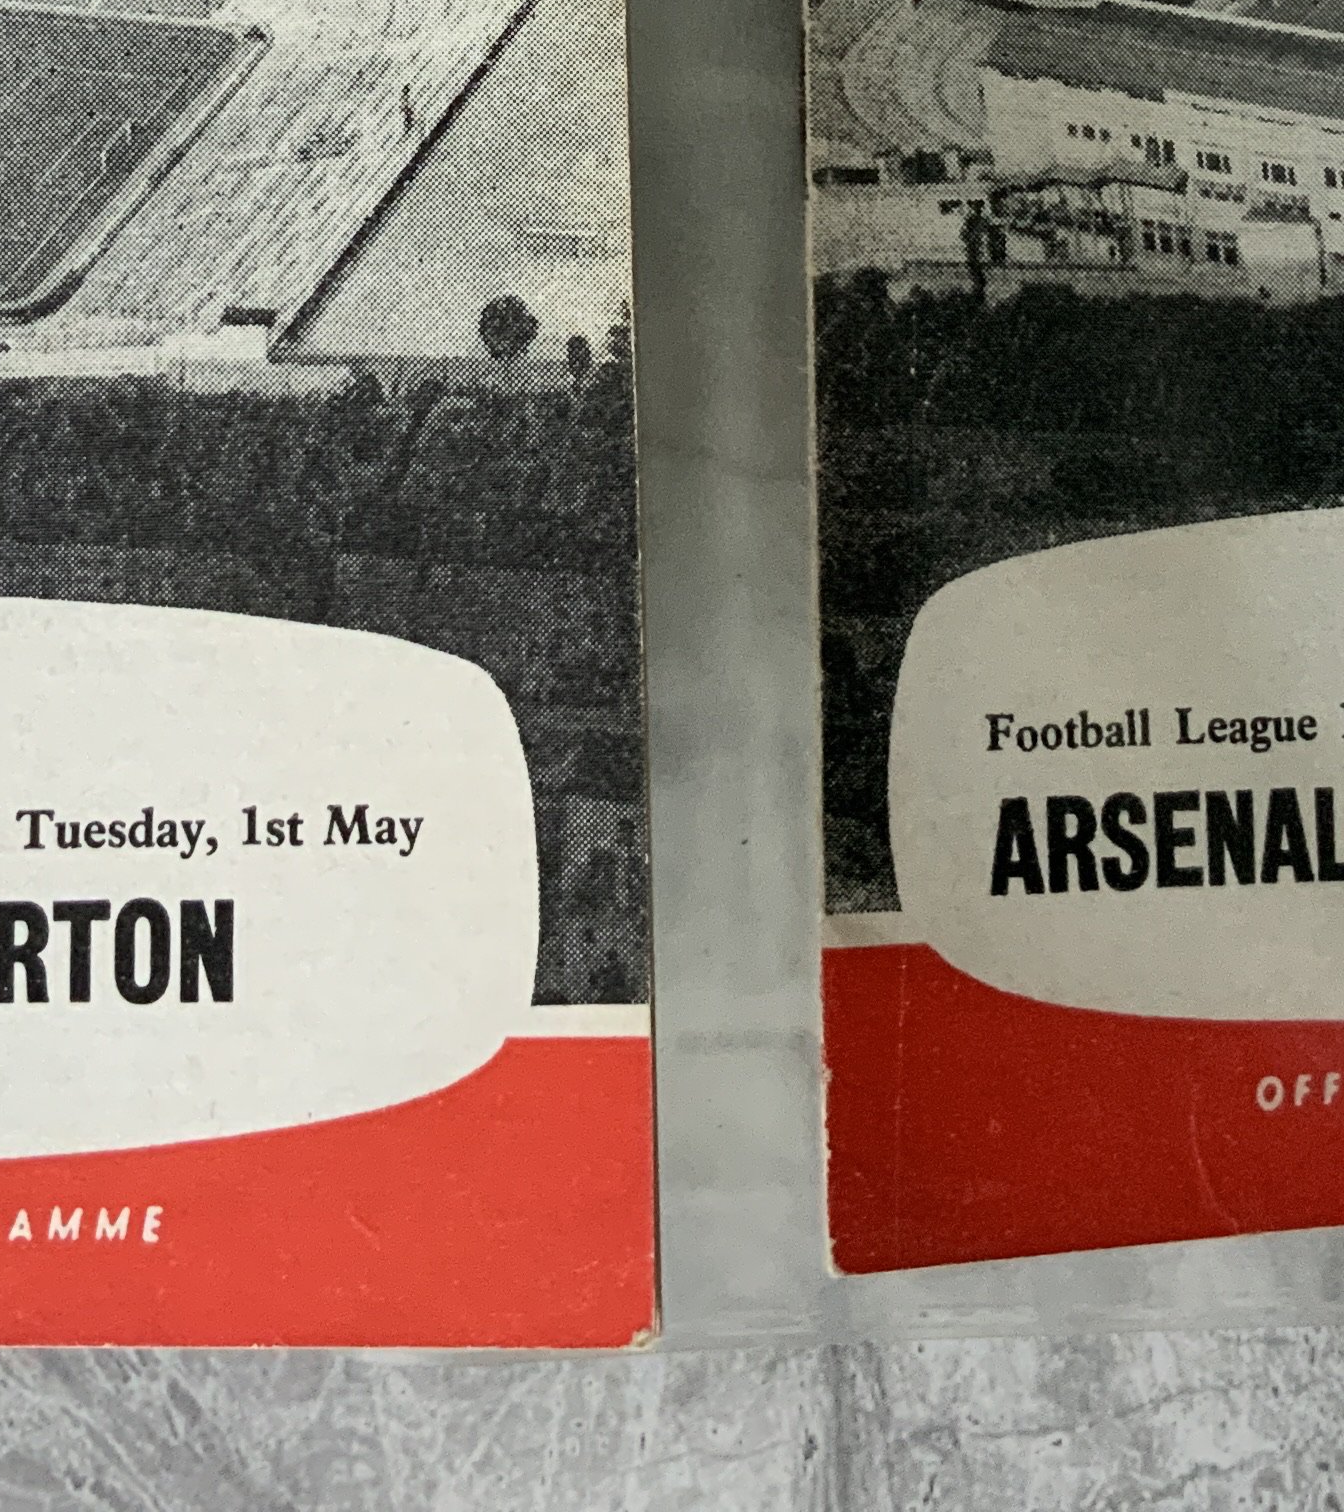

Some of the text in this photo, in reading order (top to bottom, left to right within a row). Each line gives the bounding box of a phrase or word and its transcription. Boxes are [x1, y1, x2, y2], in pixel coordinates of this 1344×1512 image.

[985, 708, 1151, 751] Football
[1175, 707, 1318, 753] League
[16, 807, 219, 858] Tuesday,
[242, 805, 304, 848] 1st
[323, 804, 424, 857] May
